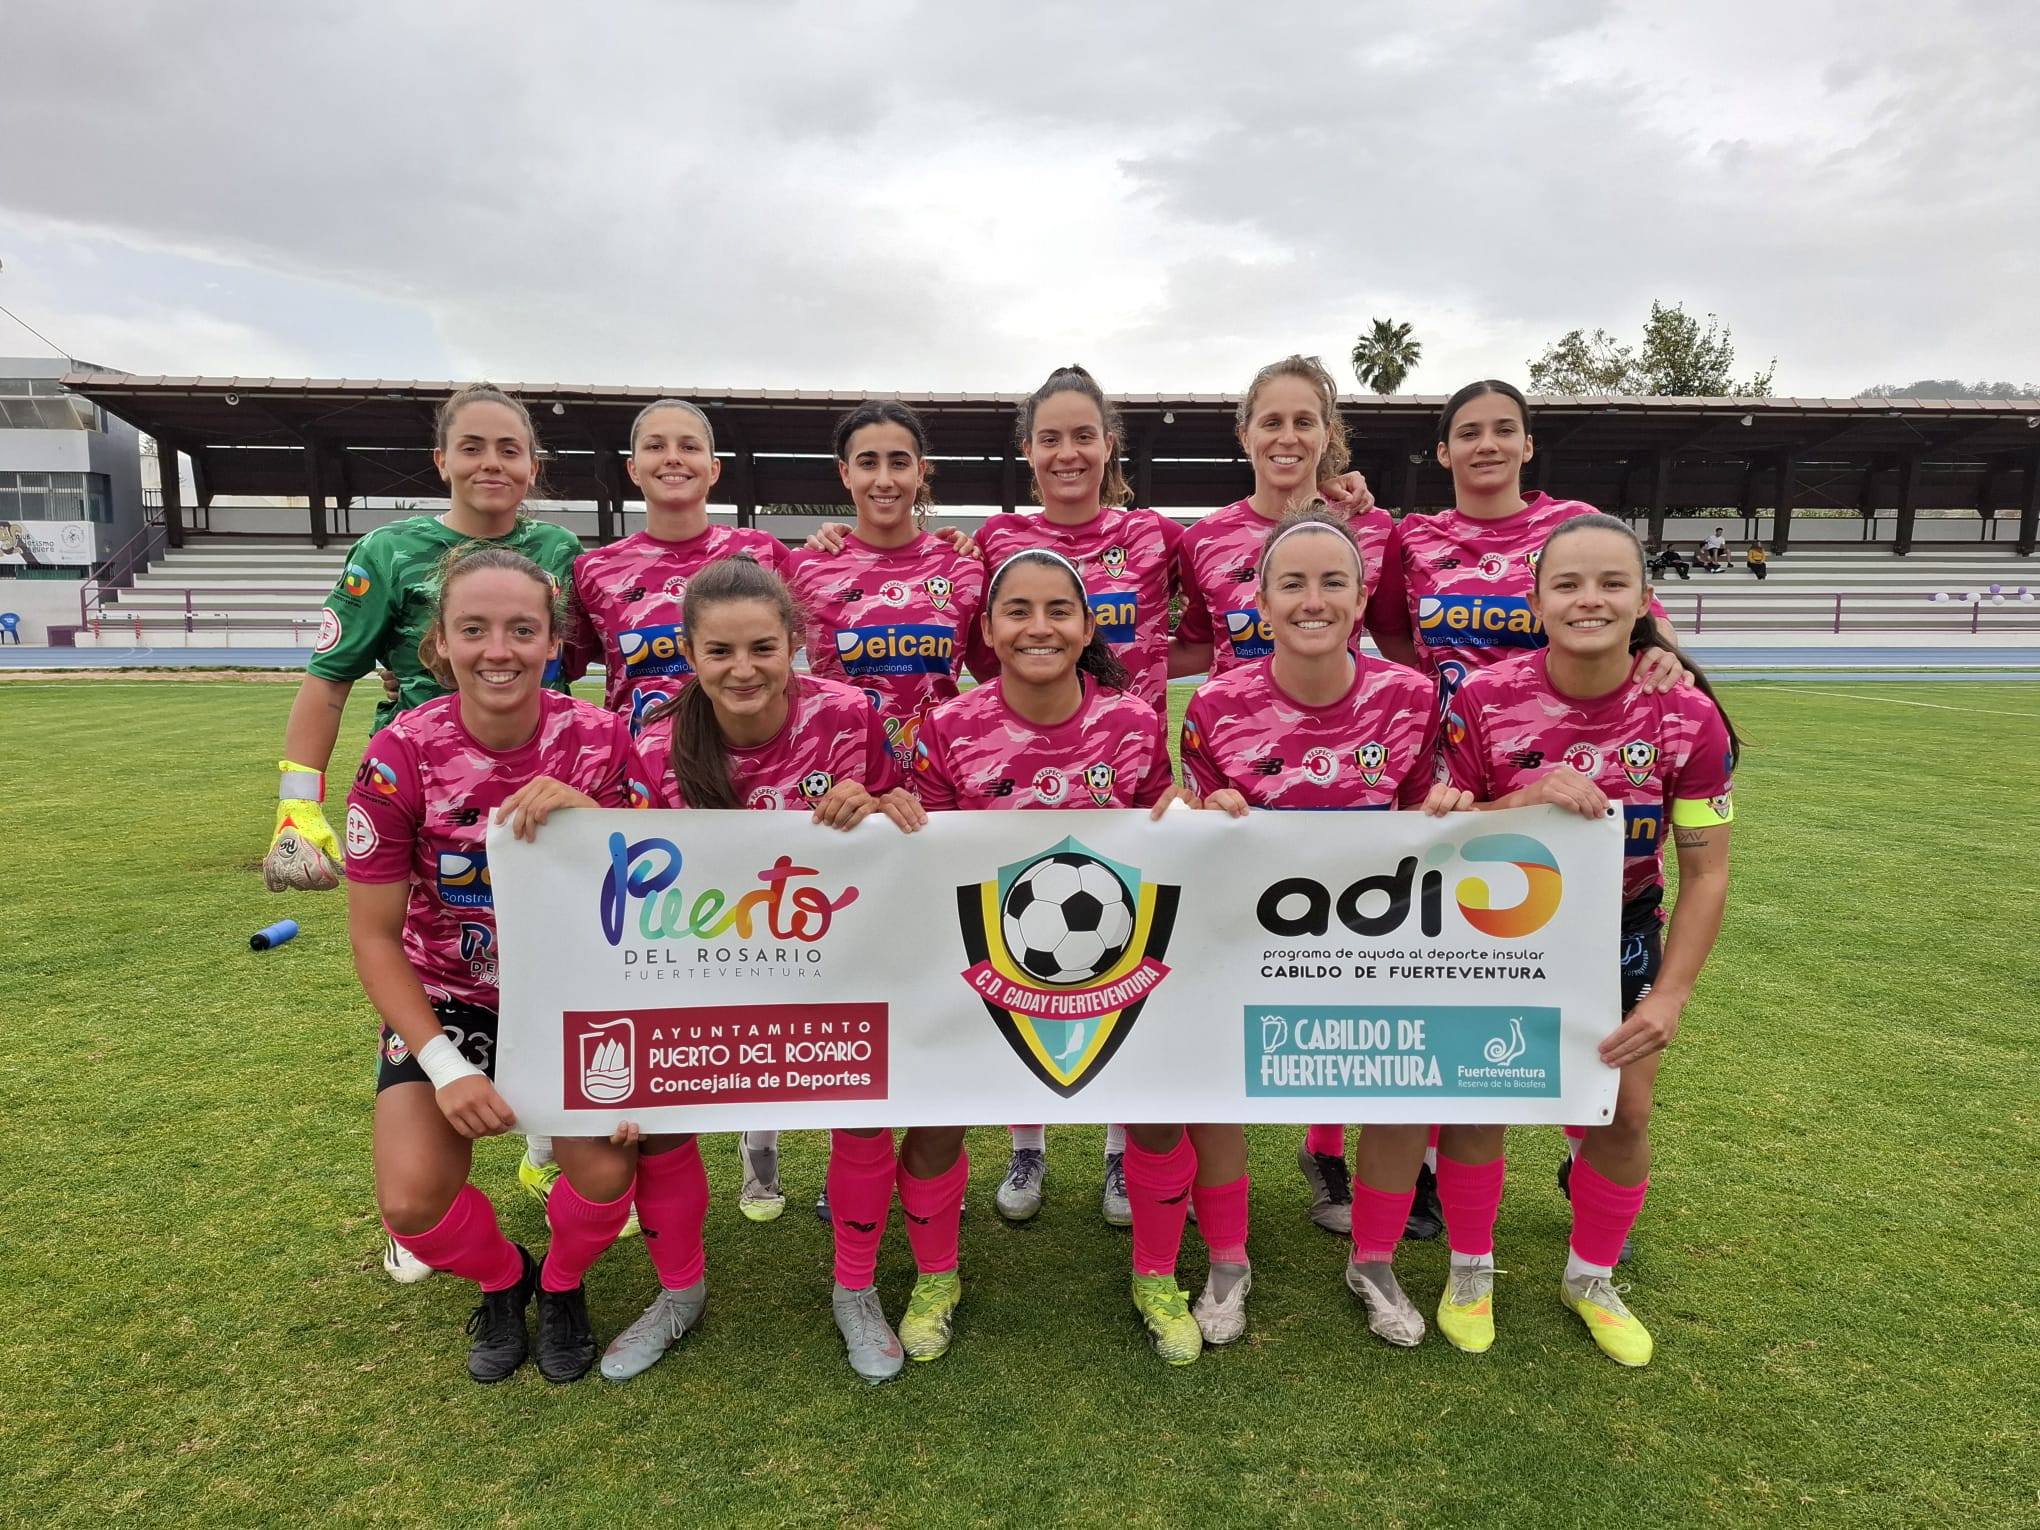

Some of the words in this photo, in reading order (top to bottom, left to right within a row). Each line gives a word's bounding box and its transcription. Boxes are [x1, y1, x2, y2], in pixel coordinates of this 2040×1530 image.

[666, 576, 688, 587] RESPEC
[619, 626, 685, 665] Dei
[836, 627, 952, 661] Deican
[1235, 646, 1273, 656] Construc
[1307, 749, 1334, 760] RESPECT
[1569, 744, 1599, 756] RESPECT
[1037, 768, 1064, 779] RESPECT
[751, 787, 779, 801] RESPECT
[600, 831, 860, 946] Puerto
[441, 891, 493, 904] Constru
[624, 949, 678, 965] DEL
[697, 947, 822, 963] ROSARIO
[1263, 949, 1332, 962] programa
[1335, 948, 1354, 959] de
[1358, 948, 1405, 961] ayuda
[1409, 948, 1423, 959] al
[1427, 948, 1489, 961] deporte
[1492, 948, 1545, 960] insular
[470, 961, 496, 975] DE
[624, 967, 822, 981] FUERTEVENTURA
[1261, 965, 1342, 978] CABILDO
[1355, 966, 1377, 978] DE
[1389, 966, 1546, 980] FUERTEVENTURA
[974, 969, 999, 999] C.D.
[1002, 986, 1050, 1014] CADAY
[1050, 965, 1161, 1015] FUERTEVENTURA
[651, 1021, 871, 1041] AYUNTAMIENTO
[1294, 1018, 1391, 1050] CABILDO
[1398, 1020, 1426, 1050] DE
[649, 1044, 730, 1069] PUERTO
[739, 1043, 777, 1065] DEL
[785, 1040, 872, 1063] ROSARIO
[1260, 1054, 1444, 1087] FUERTEVENTURA
[1457, 1065, 1546, 1078] Fuerteventura
[650, 1072, 752, 1094] Concejalía
[757, 1072, 781, 1089] de
[786, 1070, 872, 1091] Deportes
[1457, 1079, 1488, 1088] Reserva
[1490, 1079, 1502, 1088] de
[1504, 1079, 1511, 1088] la
[1513, 1079, 1546, 1088] Biosfera
